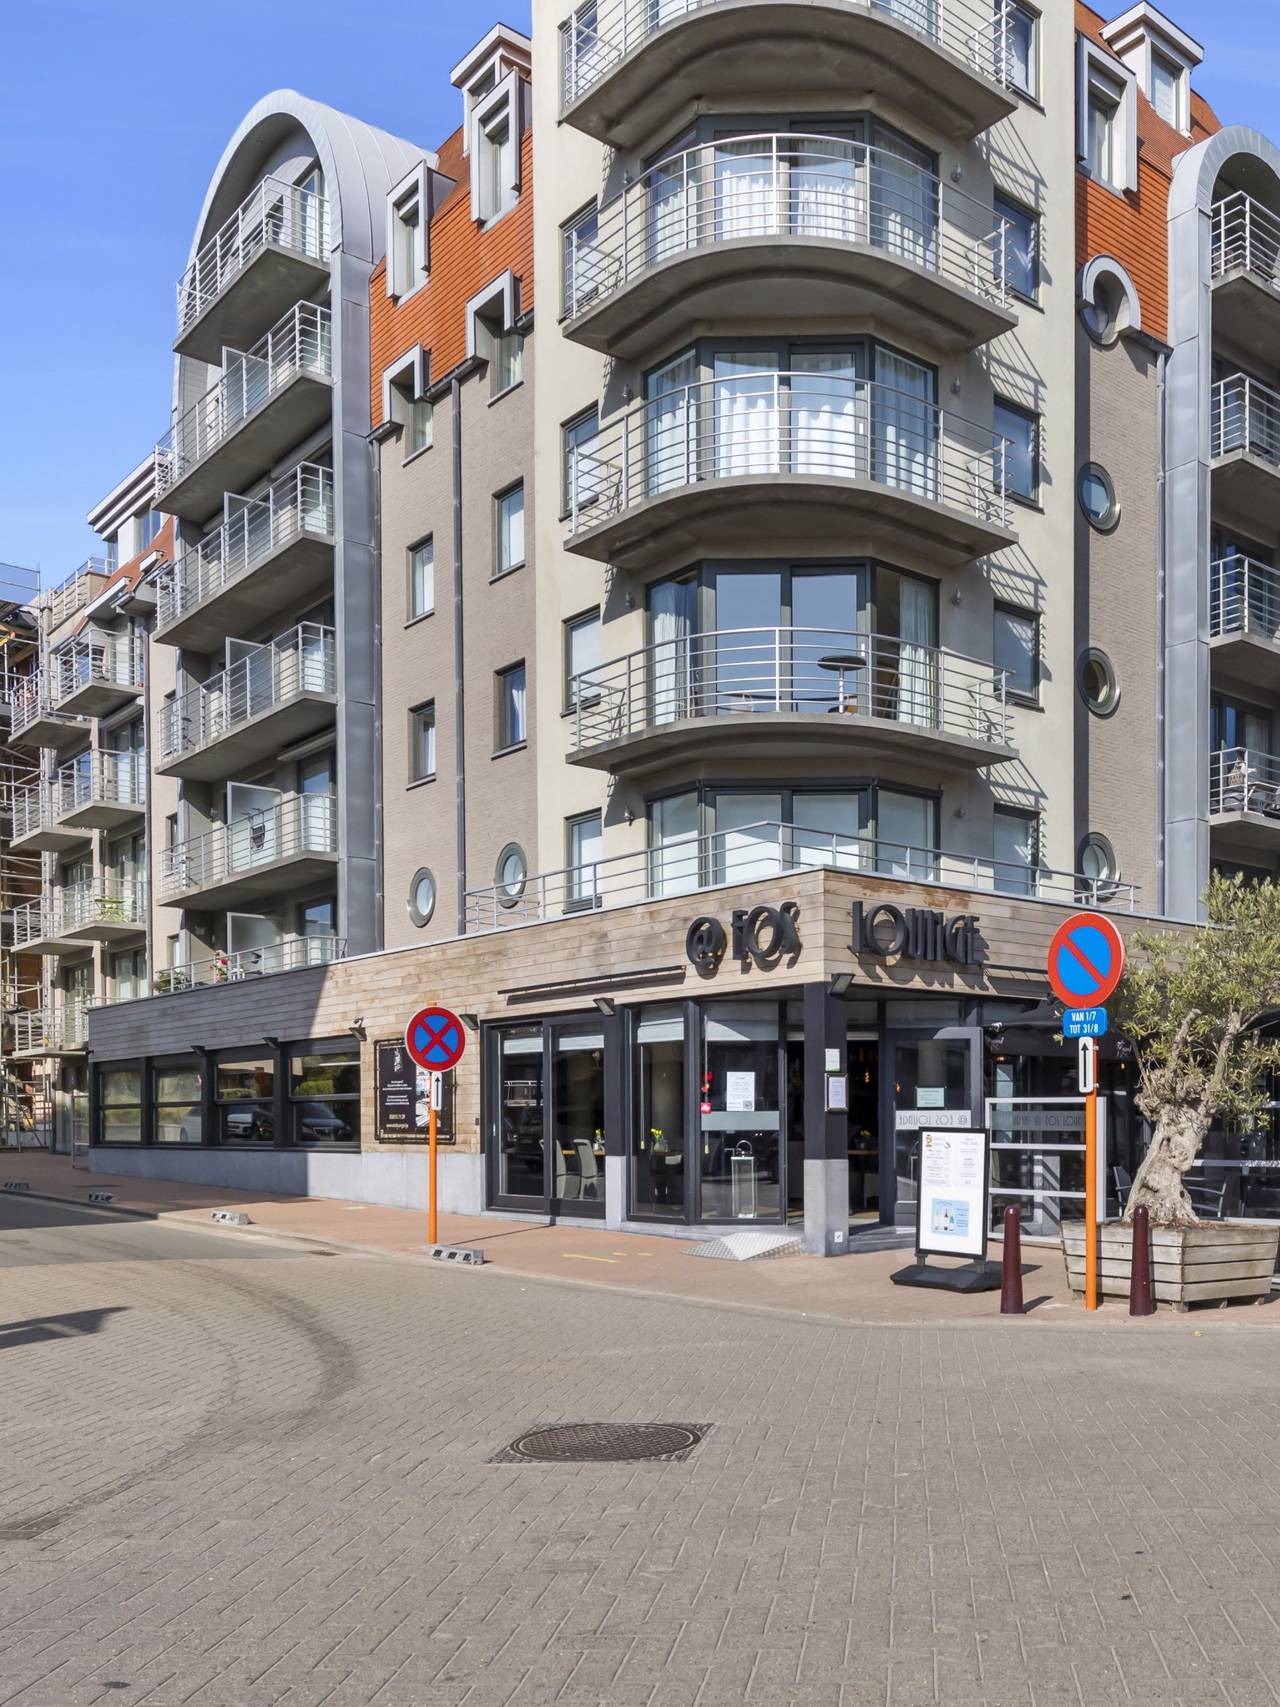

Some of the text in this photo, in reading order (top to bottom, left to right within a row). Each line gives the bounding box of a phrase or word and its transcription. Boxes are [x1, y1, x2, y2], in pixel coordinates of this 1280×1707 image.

[1071, 1011, 1097, 1022] VAN 1/7
[1069, 1023, 1099, 1034] TOT 31/8
